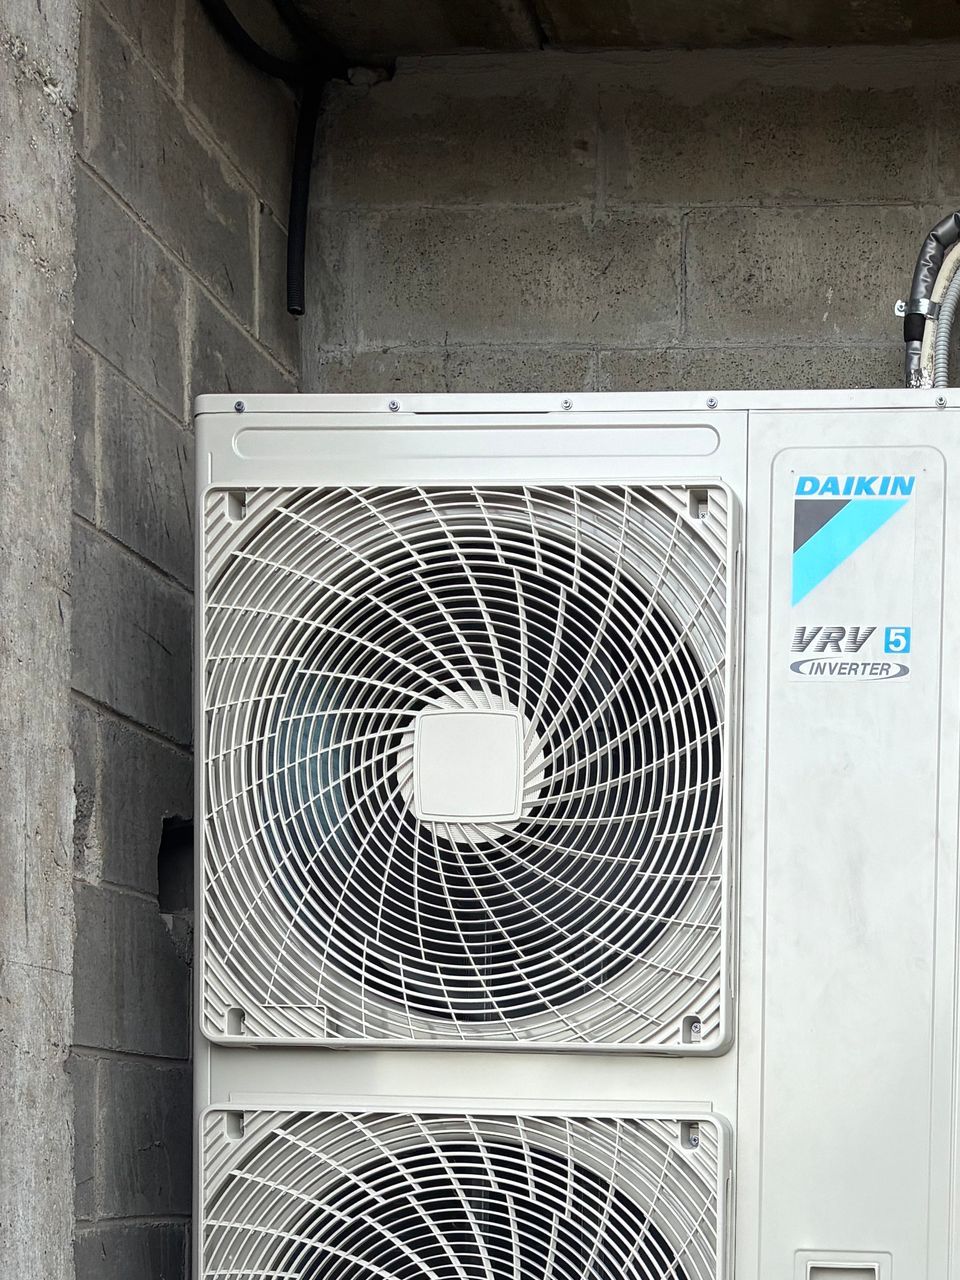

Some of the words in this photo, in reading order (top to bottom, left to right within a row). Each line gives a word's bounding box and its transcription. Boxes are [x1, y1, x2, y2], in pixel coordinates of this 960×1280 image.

[795, 476, 915, 496] DAIKIN
[790, 626, 877, 653] VRV
[888, 627, 908, 653] 5
[808, 662, 892, 676] INVERTER
